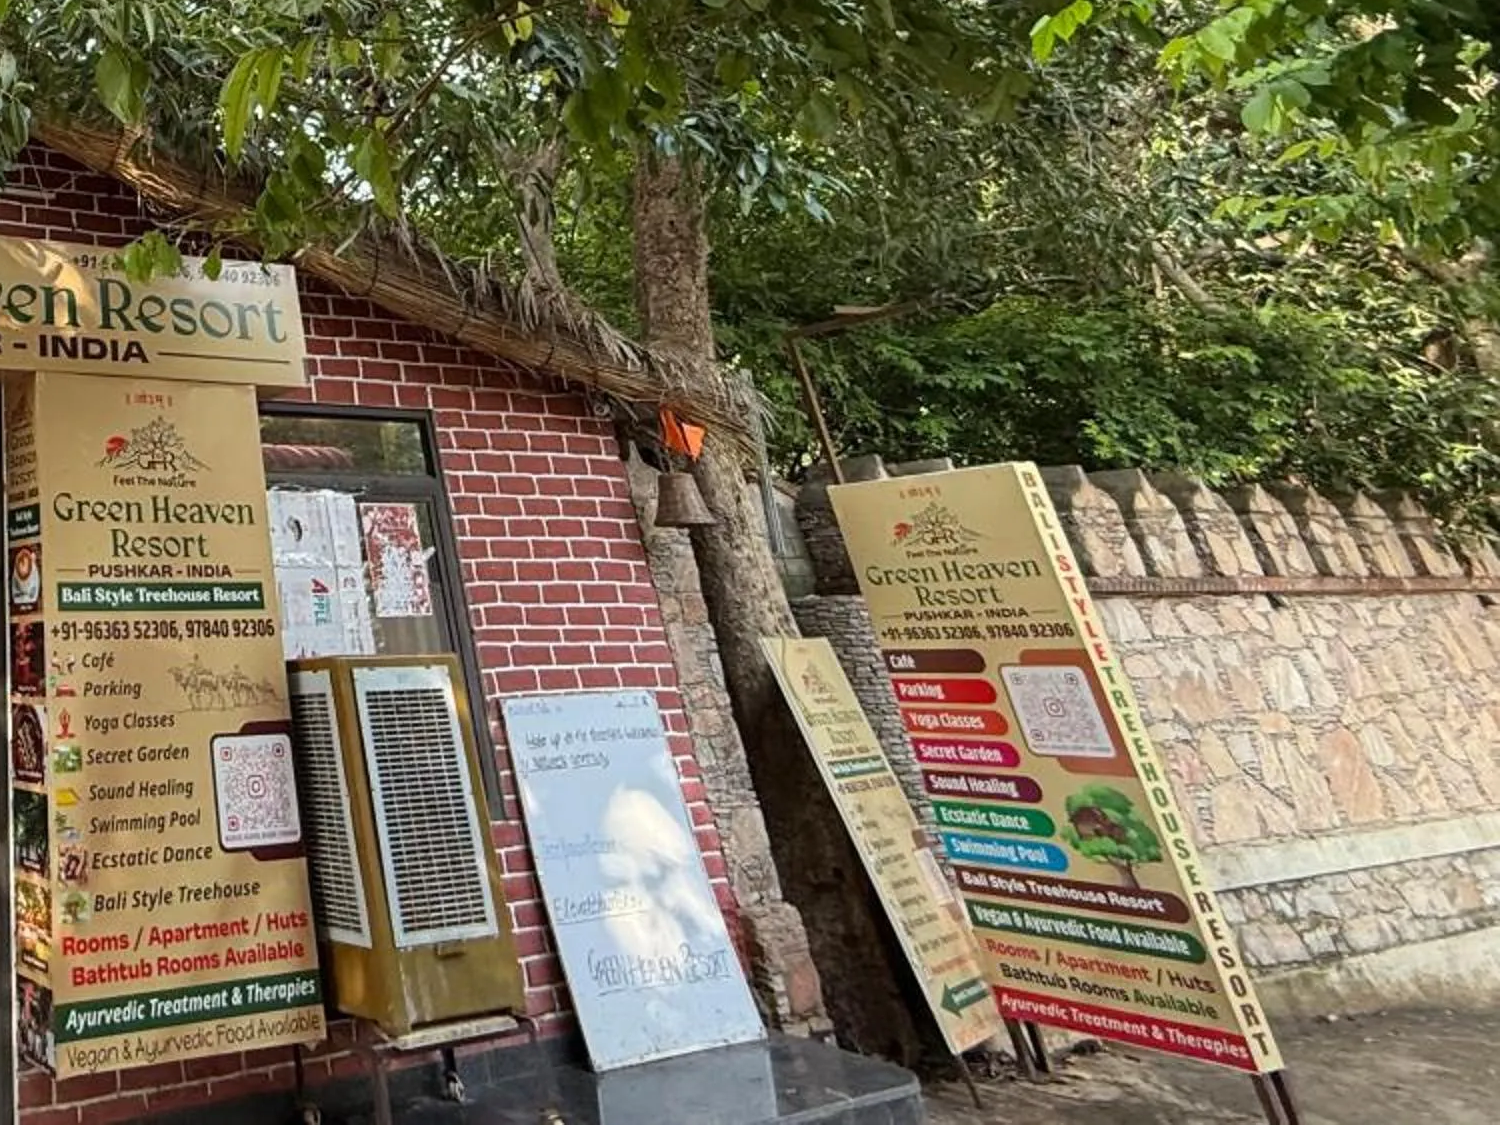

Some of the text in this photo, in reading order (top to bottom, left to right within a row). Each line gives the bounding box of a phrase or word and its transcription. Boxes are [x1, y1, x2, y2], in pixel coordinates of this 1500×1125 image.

[98, 278, 287, 344] Resort
[38, 333, 150, 364] INDIA
[113, 475, 196, 488] Feel The Nature
[53, 493, 255, 525] Green Heaven
[111, 528, 209, 558] Resort
[88, 564, 233, 578] PUSHKAR INDIA
[866, 558, 1042, 586] Green Heaven
[61, 587, 260, 606] Bali Style Treehouse Resort
[311, 578, 332, 627] APPLE
[915, 584, 1003, 607] Resort
[903, 607, 1029, 622] PUSHKAR INDIA
[50, 618, 275, 642] +91-96363 52306, 97840 92306
[1029, 622, 1075, 638] 92306
[82, 651, 116, 672] Café
[84, 681, 143, 700] Parking
[899, 682, 945, 700] Parking
[84, 712, 176, 734] Yoga Classes
[910, 712, 985, 729] Yoga Classes
[86, 745, 190, 765] Secret Garden
[919, 743, 1004, 763] Secret Garden
[88, 781, 194, 802] Sound Healing
[930, 775, 1020, 798] Sound Healing
[90, 811, 201, 835] Swimming Pool
[940, 807, 1031, 830] Ecstatic Dance
[91, 845, 213, 870] Ecstatic Dance
[953, 838, 1048, 863] Swimming Pool
[94, 880, 261, 913] Bali Style Treehouse
[962, 872, 1165, 913] Bali Style Treehouse Resort
[62, 910, 309, 956] Rooms / Apartment Huts
[973, 905, 1190, 956] Vegan Ayurvedic Food Available
[72, 958, 152, 988] Bathtub
[157, 953, 221, 976] Rooms
[223, 940, 305, 966] Available
[986, 938, 1217, 995] Rooms Apartment Huts
[999, 963, 1068, 990] Bathtub
[1070, 977, 1130, 1001] Rooms
[1133, 988, 1219, 1019] Available
[65, 978, 316, 1033] Ayurvedic Treatment & Therapies
[1001, 994, 1068, 1021] Ayurvedic
[1069, 1008, 1150, 1038] Treatment
[1166, 1029, 1250, 1059] Therapies
[66, 1045, 119, 1072] Vegan
[122, 1046, 133, 1062] &
[135, 1026, 214, 1063] Ayurvedic
[216, 1022, 256, 1042] Food
[257, 1010, 321, 1038] Available
